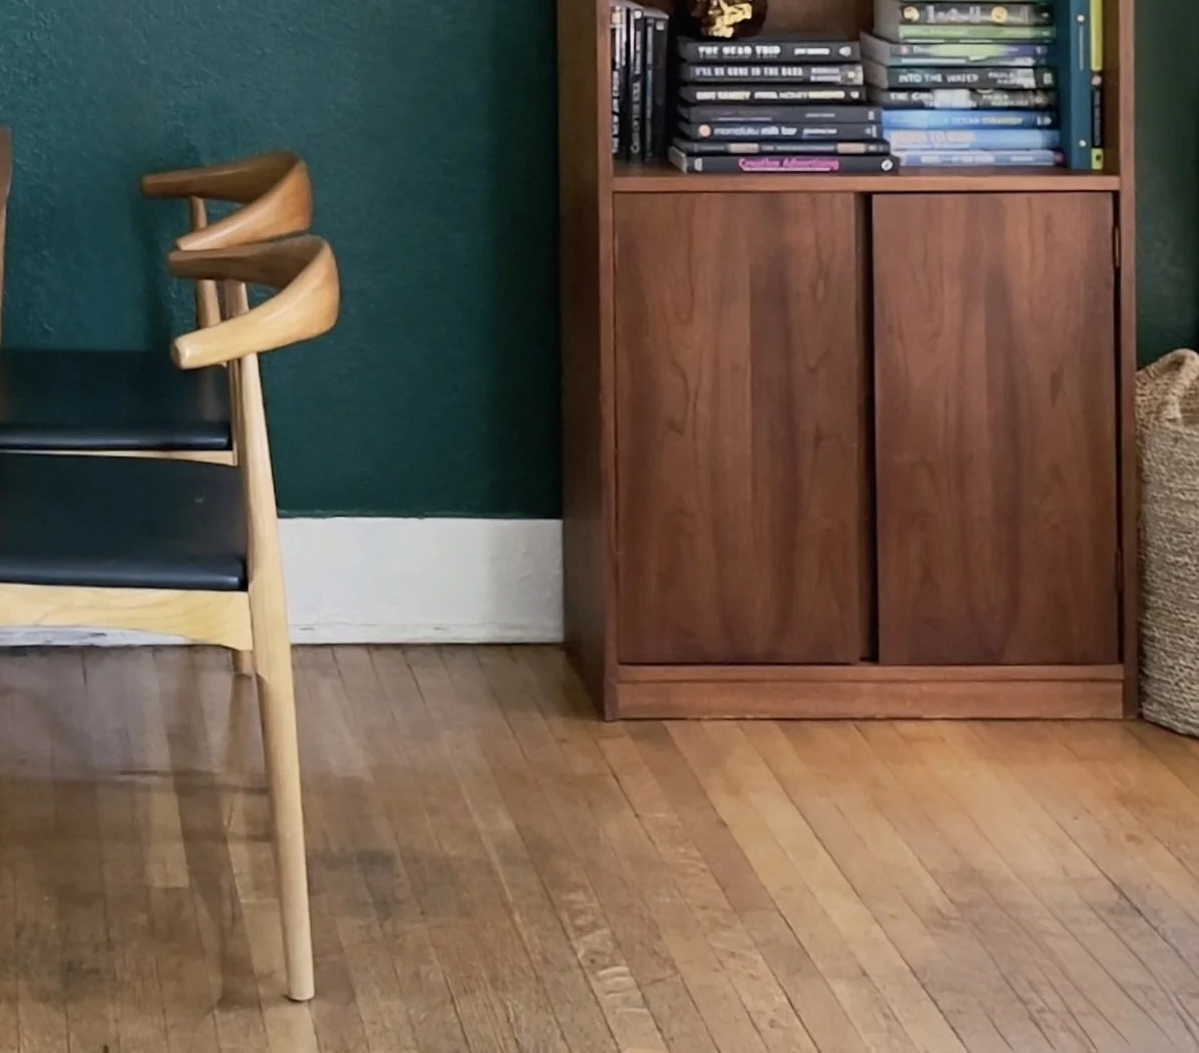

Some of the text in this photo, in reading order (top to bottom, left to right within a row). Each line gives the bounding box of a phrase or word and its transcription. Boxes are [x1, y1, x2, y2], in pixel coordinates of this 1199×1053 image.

[697, 45, 718, 55] THE
[898, 73, 979, 83] INTO THE WATER
